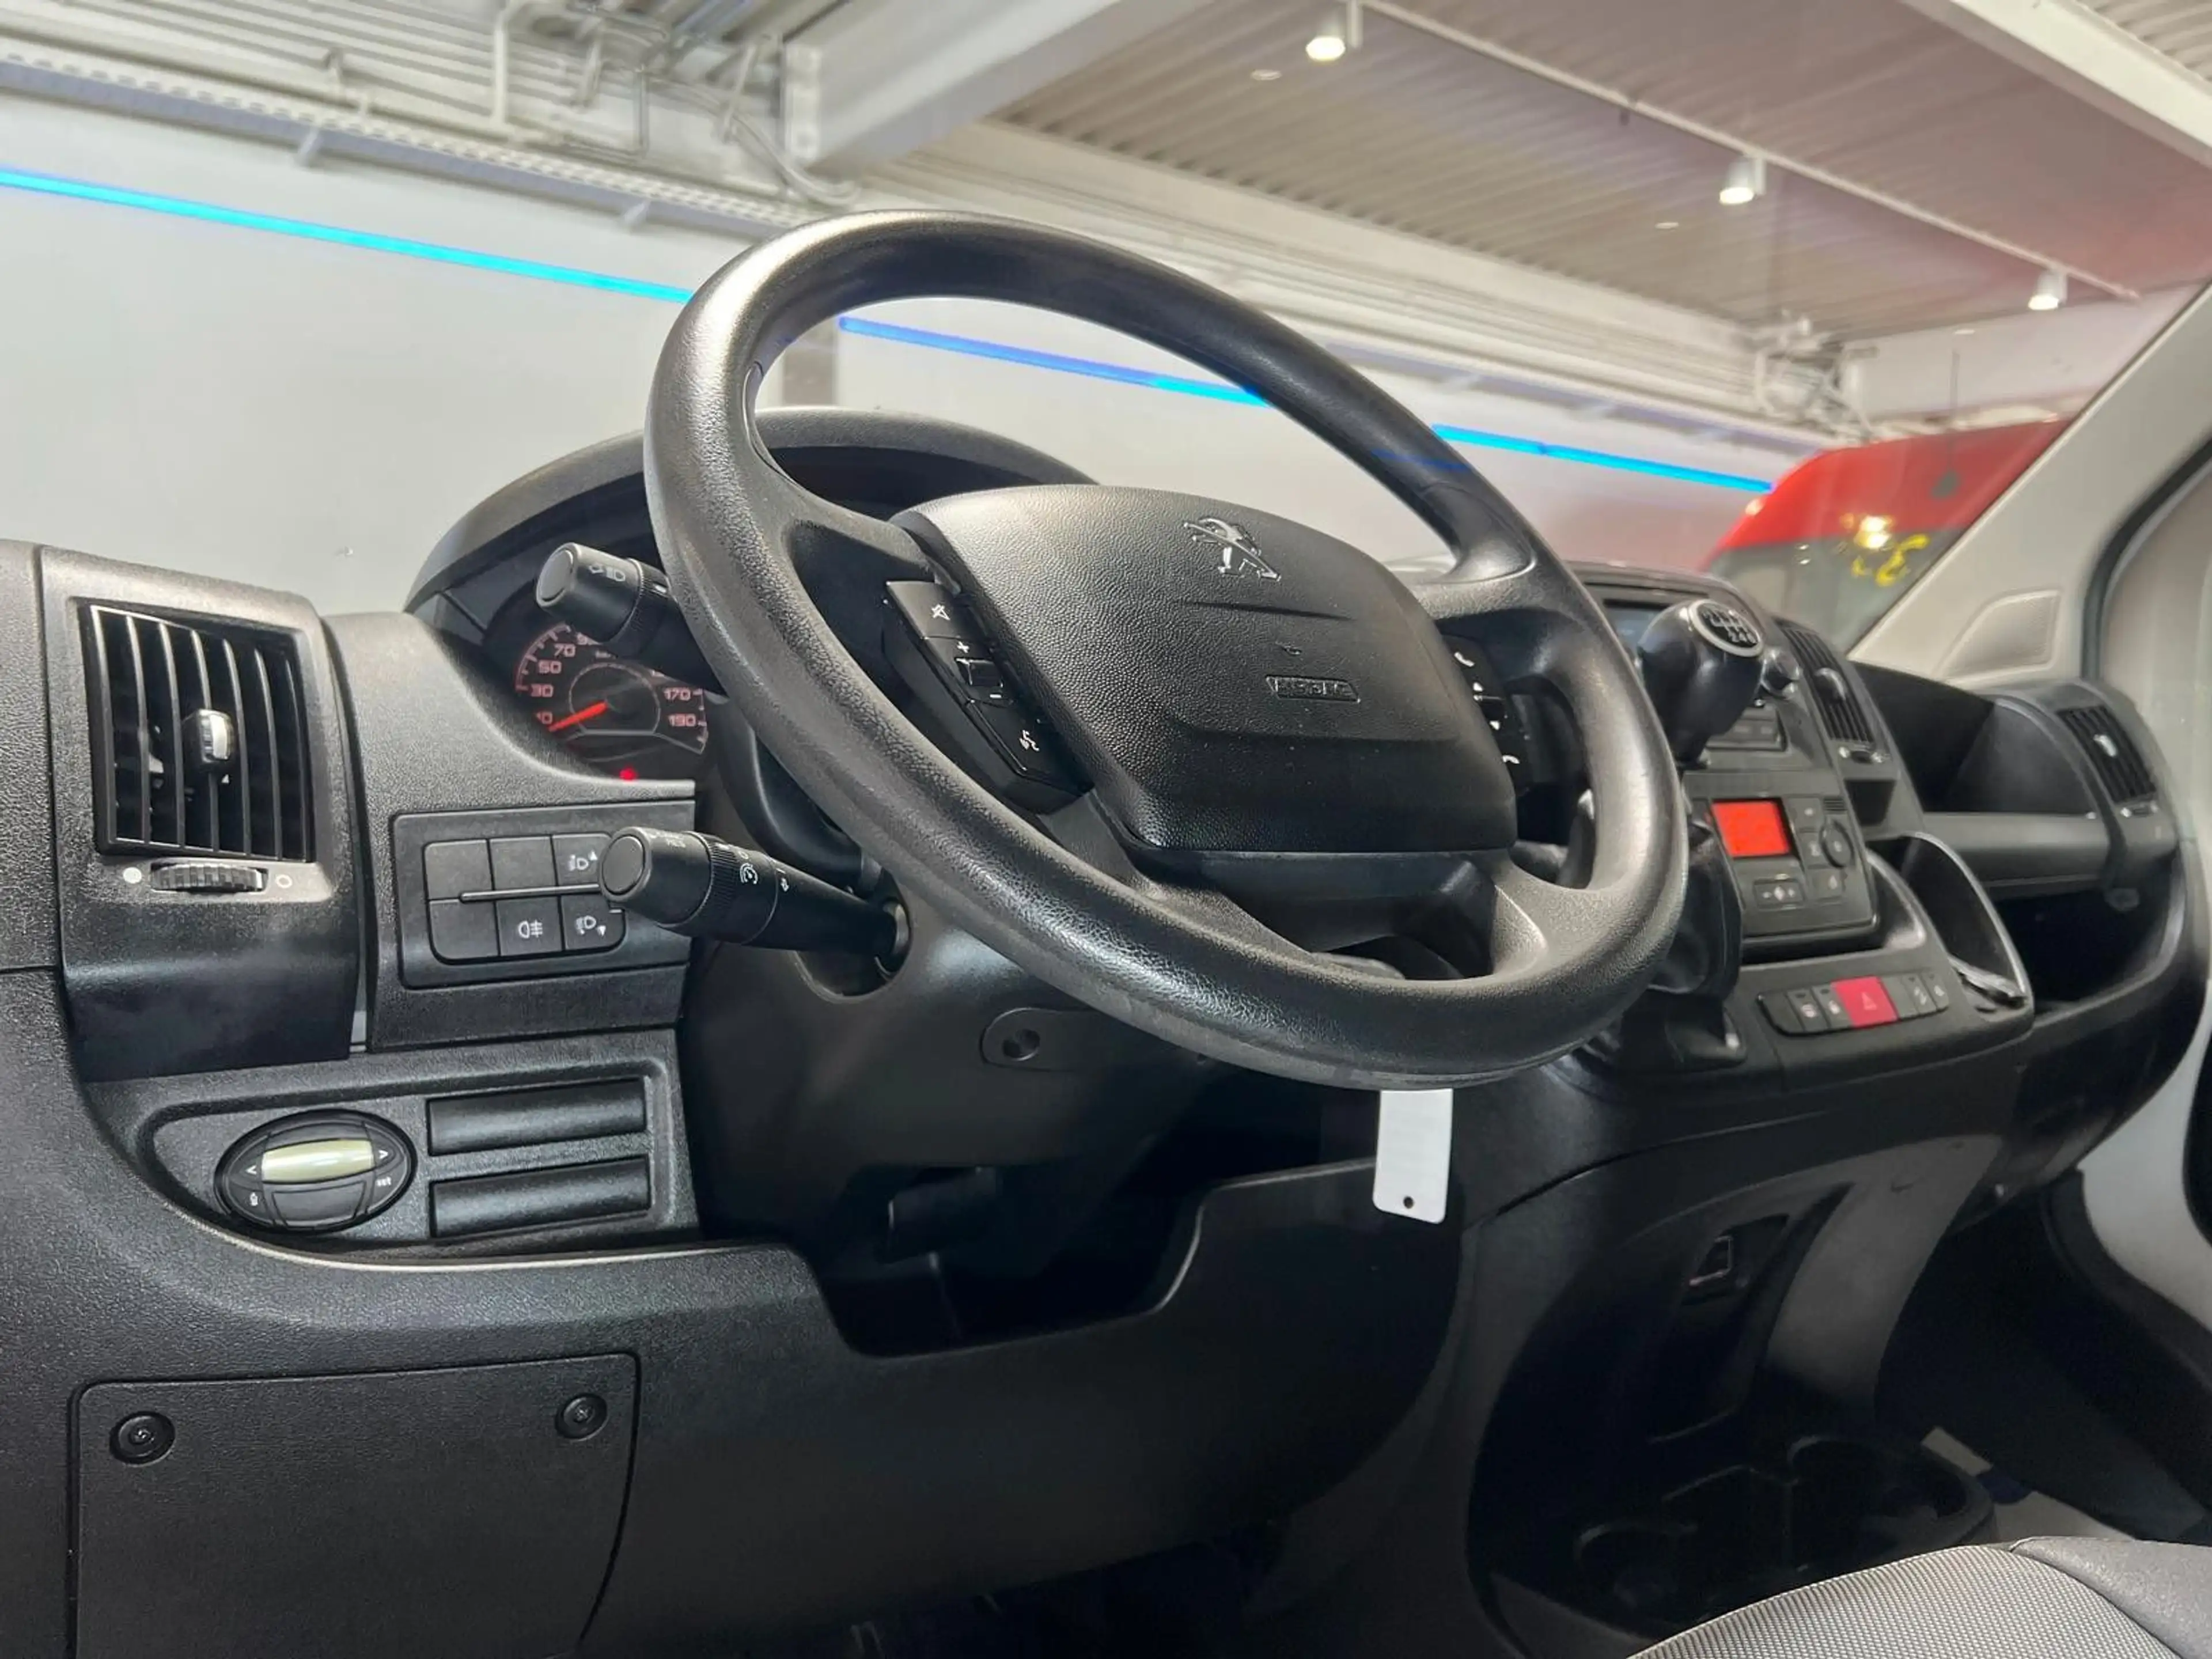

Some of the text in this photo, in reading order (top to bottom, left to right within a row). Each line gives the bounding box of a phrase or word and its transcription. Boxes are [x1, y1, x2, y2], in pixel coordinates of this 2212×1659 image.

[554, 643, 575, 657] 70
[539, 660, 562, 673] 50
[664, 687, 691, 701] 170
